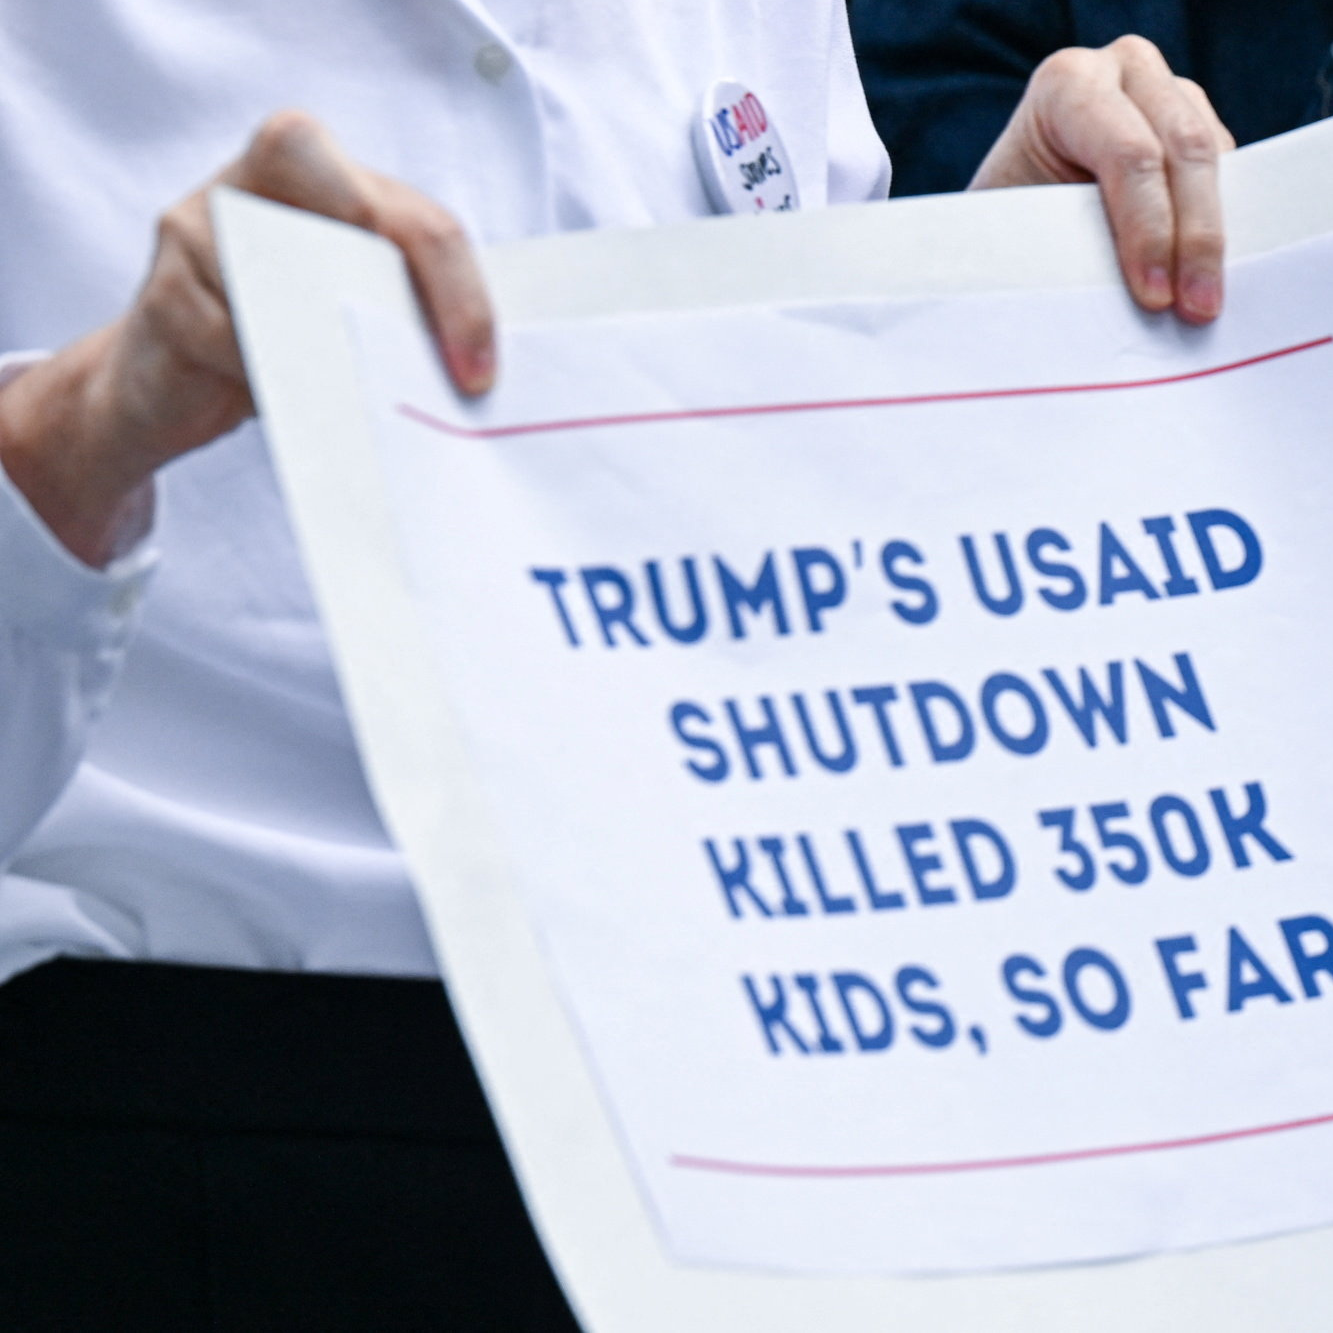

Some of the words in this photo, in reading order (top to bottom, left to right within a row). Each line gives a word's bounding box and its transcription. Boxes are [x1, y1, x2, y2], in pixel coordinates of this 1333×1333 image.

[709, 92, 767, 156] USAID
[530, 540, 940, 649] TRUMP'S
[958, 508, 1264, 617] USAID
[668, 652, 1217, 783] SHUTDOWN
[703, 817, 1018, 918] KILLED
[1037, 781, 1294, 892] 350K
[741, 965, 988, 1056] KIDS,
[1000, 947, 1132, 1039] SO
